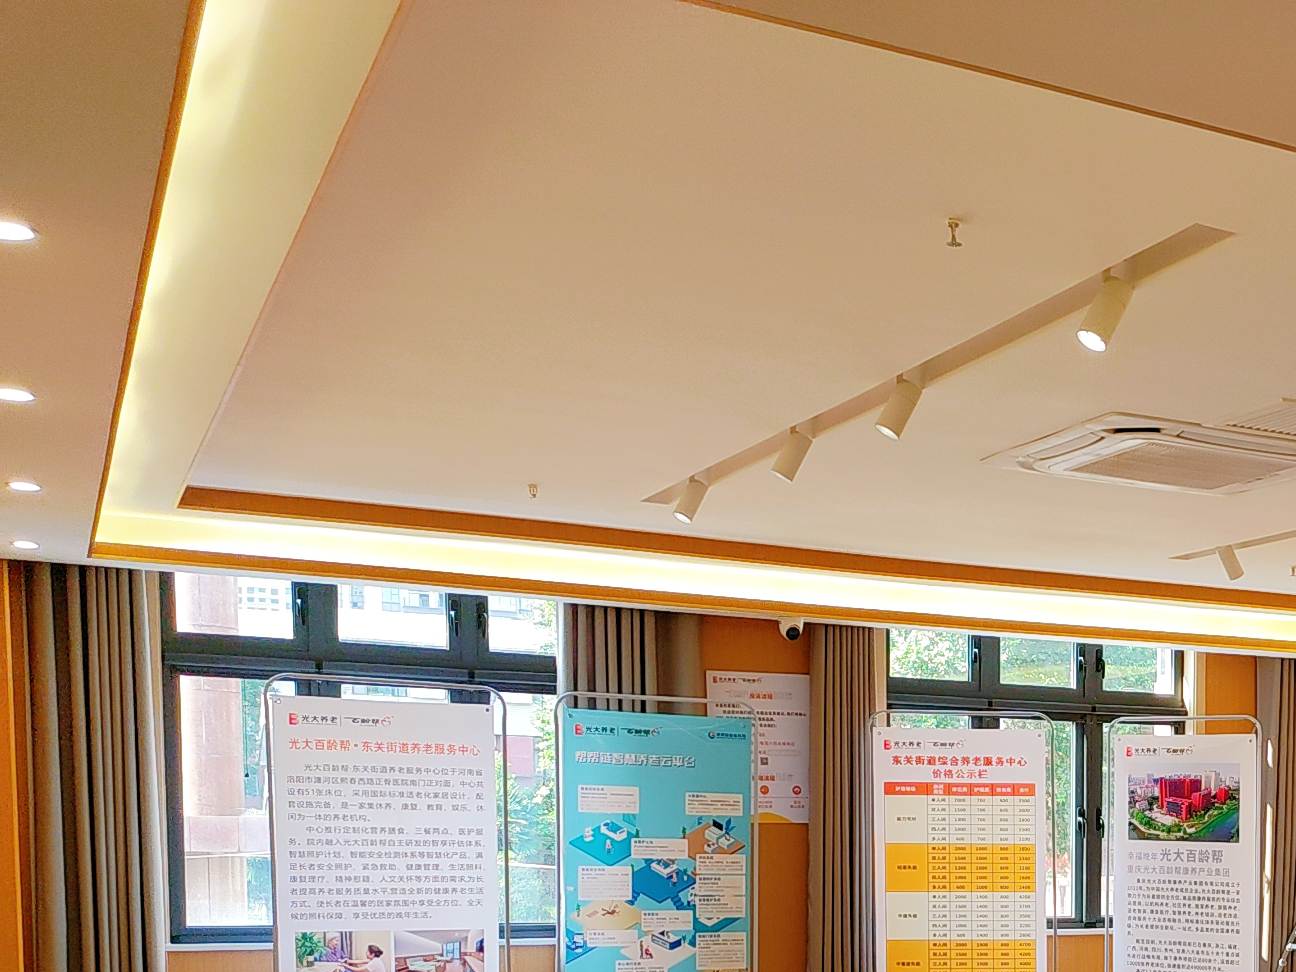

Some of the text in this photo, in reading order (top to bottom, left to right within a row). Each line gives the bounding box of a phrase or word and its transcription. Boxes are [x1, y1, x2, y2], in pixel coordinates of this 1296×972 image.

[301, 714, 338, 723] 光大养老
[288, 737, 481, 757] 光大百龄帮·东关街道养老服务中心
[891, 755, 1028, 767] 东关街道综合养老服务中心
[932, 769, 989, 779] 价格公示栏
[1160, 848, 1224, 864] 光大百龄帮
